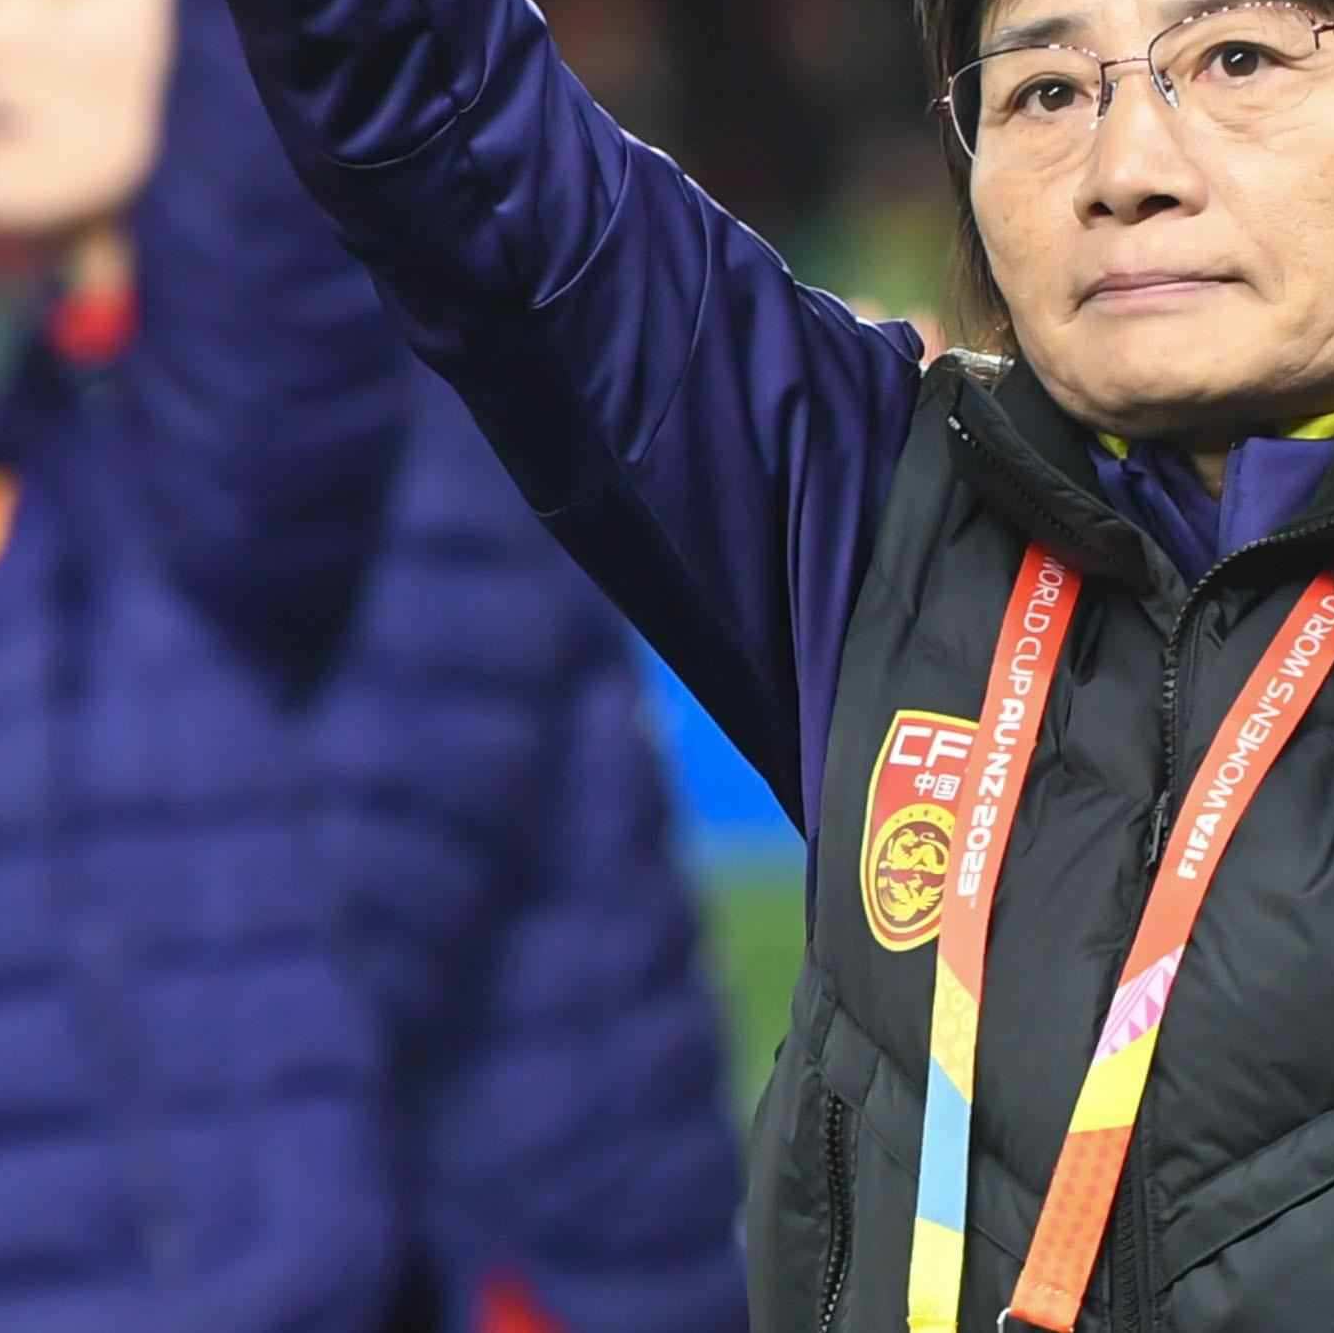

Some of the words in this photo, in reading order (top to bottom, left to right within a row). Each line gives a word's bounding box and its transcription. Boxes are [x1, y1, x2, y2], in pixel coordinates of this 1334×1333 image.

[1008, 636, 1042, 695] CUP
[889, 725, 973, 768] CF
[914, 770, 961, 801] 中国
[1177, 813, 1221, 880] FIFA
[1203, 677, 1295, 808] WOMEN'S
